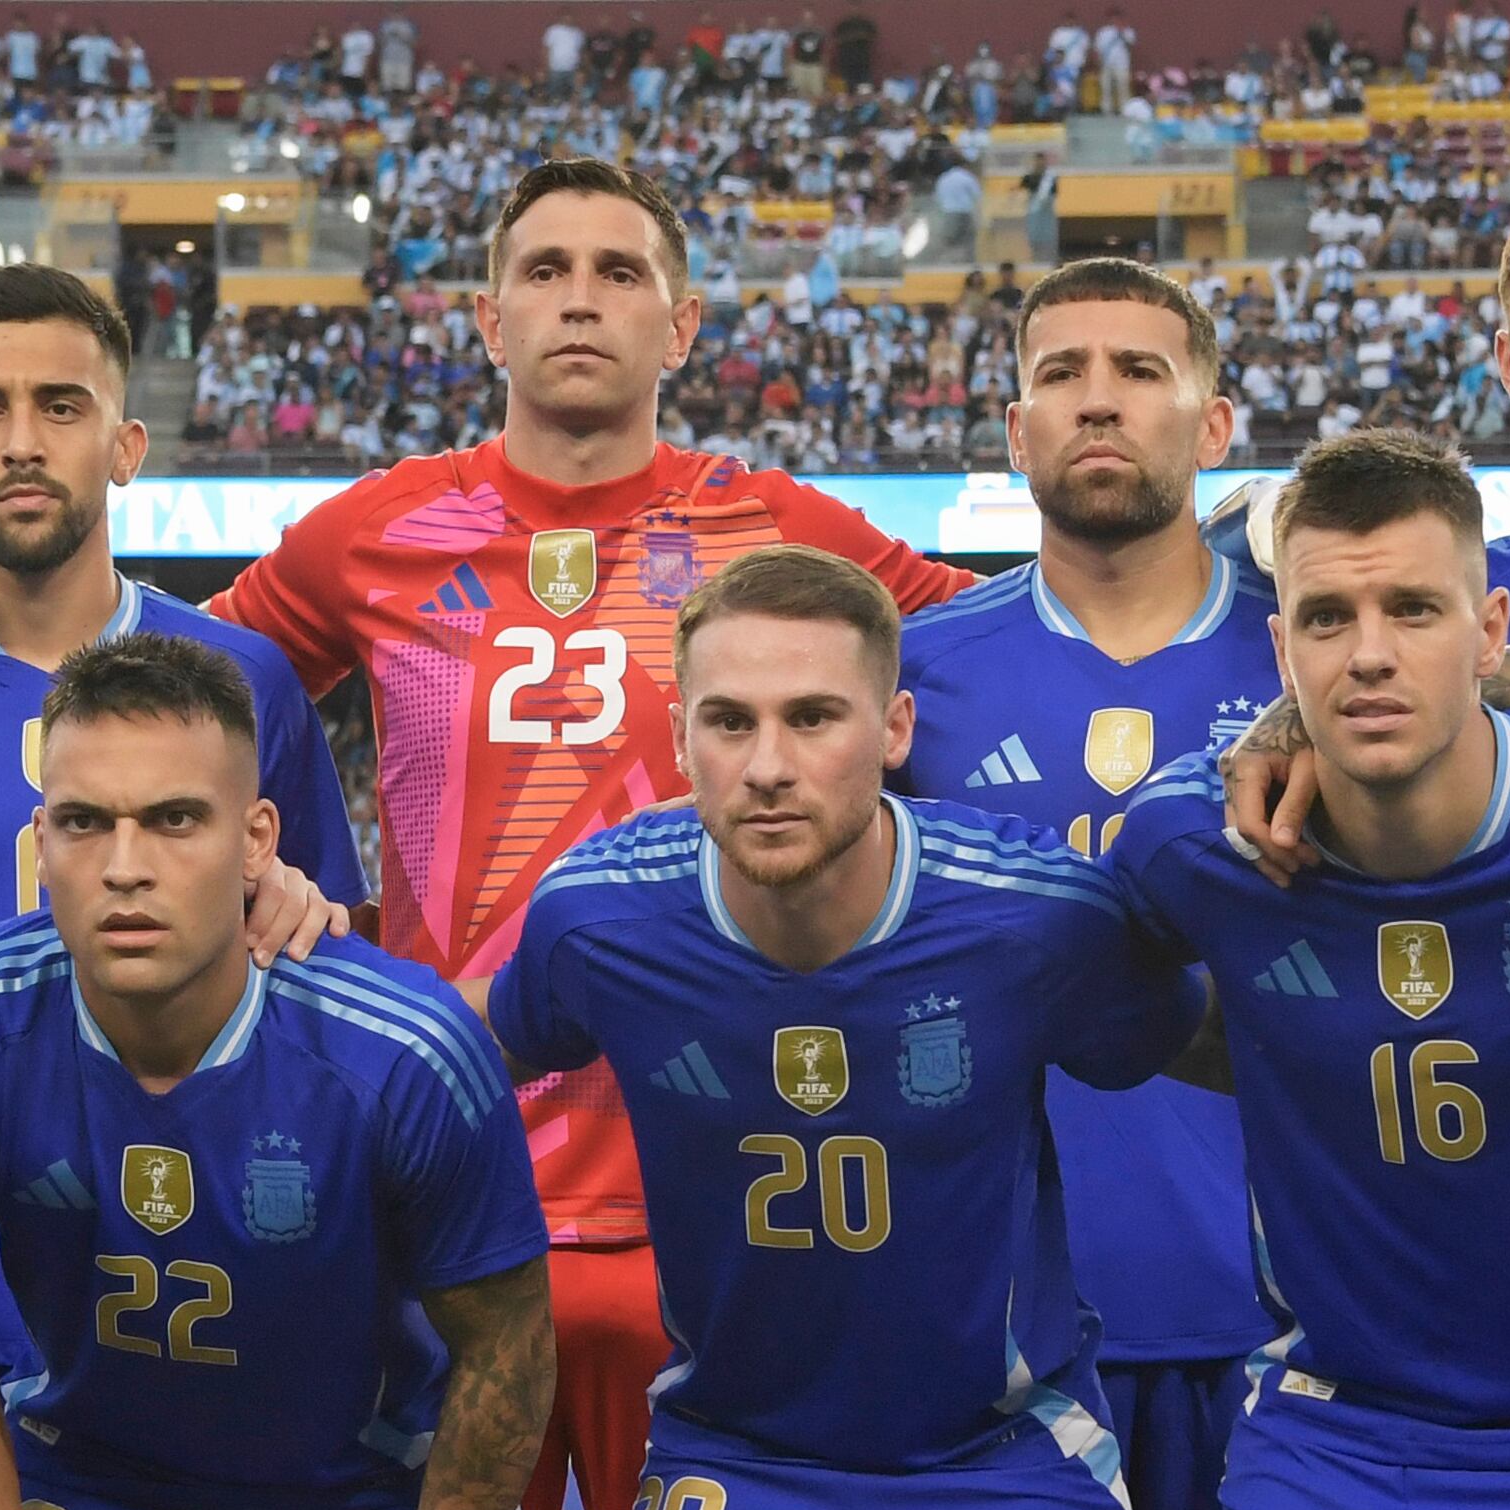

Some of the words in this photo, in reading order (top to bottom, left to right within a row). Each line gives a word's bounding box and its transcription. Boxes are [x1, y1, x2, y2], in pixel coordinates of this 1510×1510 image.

[548, 582, 579, 594] FIFA
[488, 626, 627, 744] 23
[1401, 981, 1434, 993] FIFA
[797, 1083, 830, 1094] FIFA
[1370, 1040, 1487, 1164] 16
[143, 1201, 176, 1215] FIFA
[738, 1134, 891, 1253] 20
[95, 1254, 238, 1366] 22
